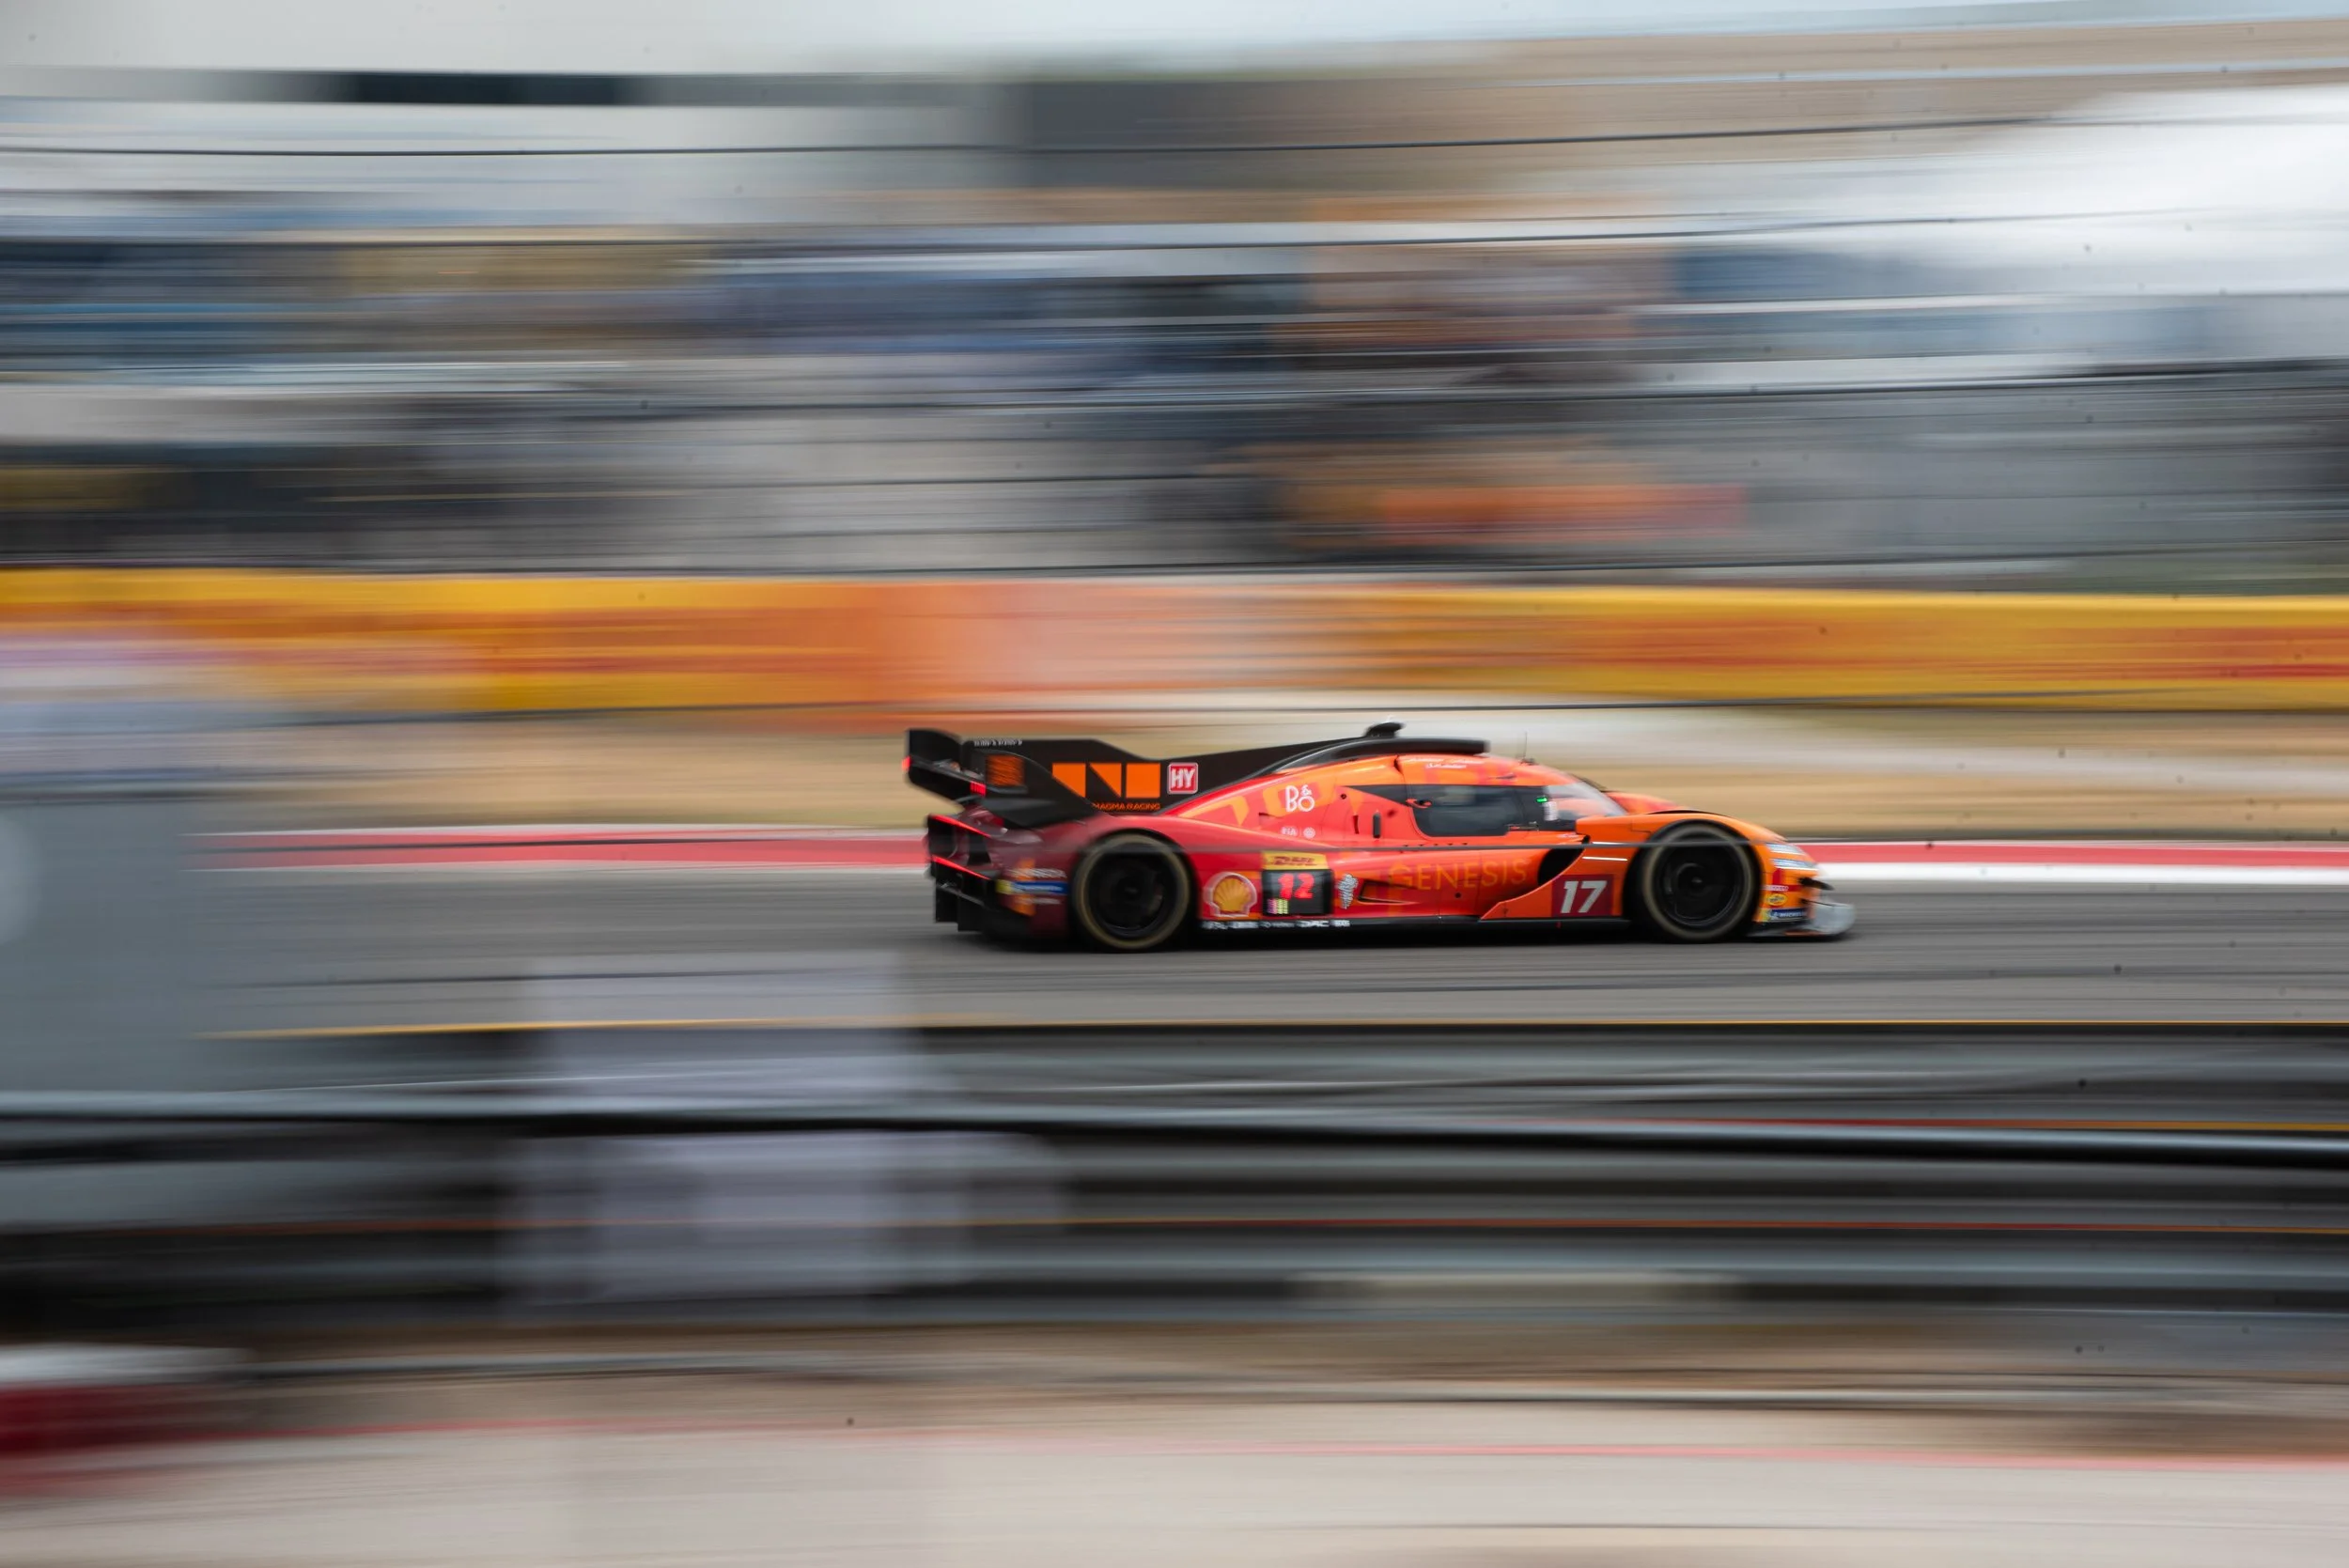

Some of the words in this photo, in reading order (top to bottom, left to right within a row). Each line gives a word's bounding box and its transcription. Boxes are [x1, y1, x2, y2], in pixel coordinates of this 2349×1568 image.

[1171, 768, 1196, 789] HY
[1127, 802, 1160, 811] RACING
[1389, 858, 1528, 891] GENESIS
[1561, 880, 1608, 914] 17
